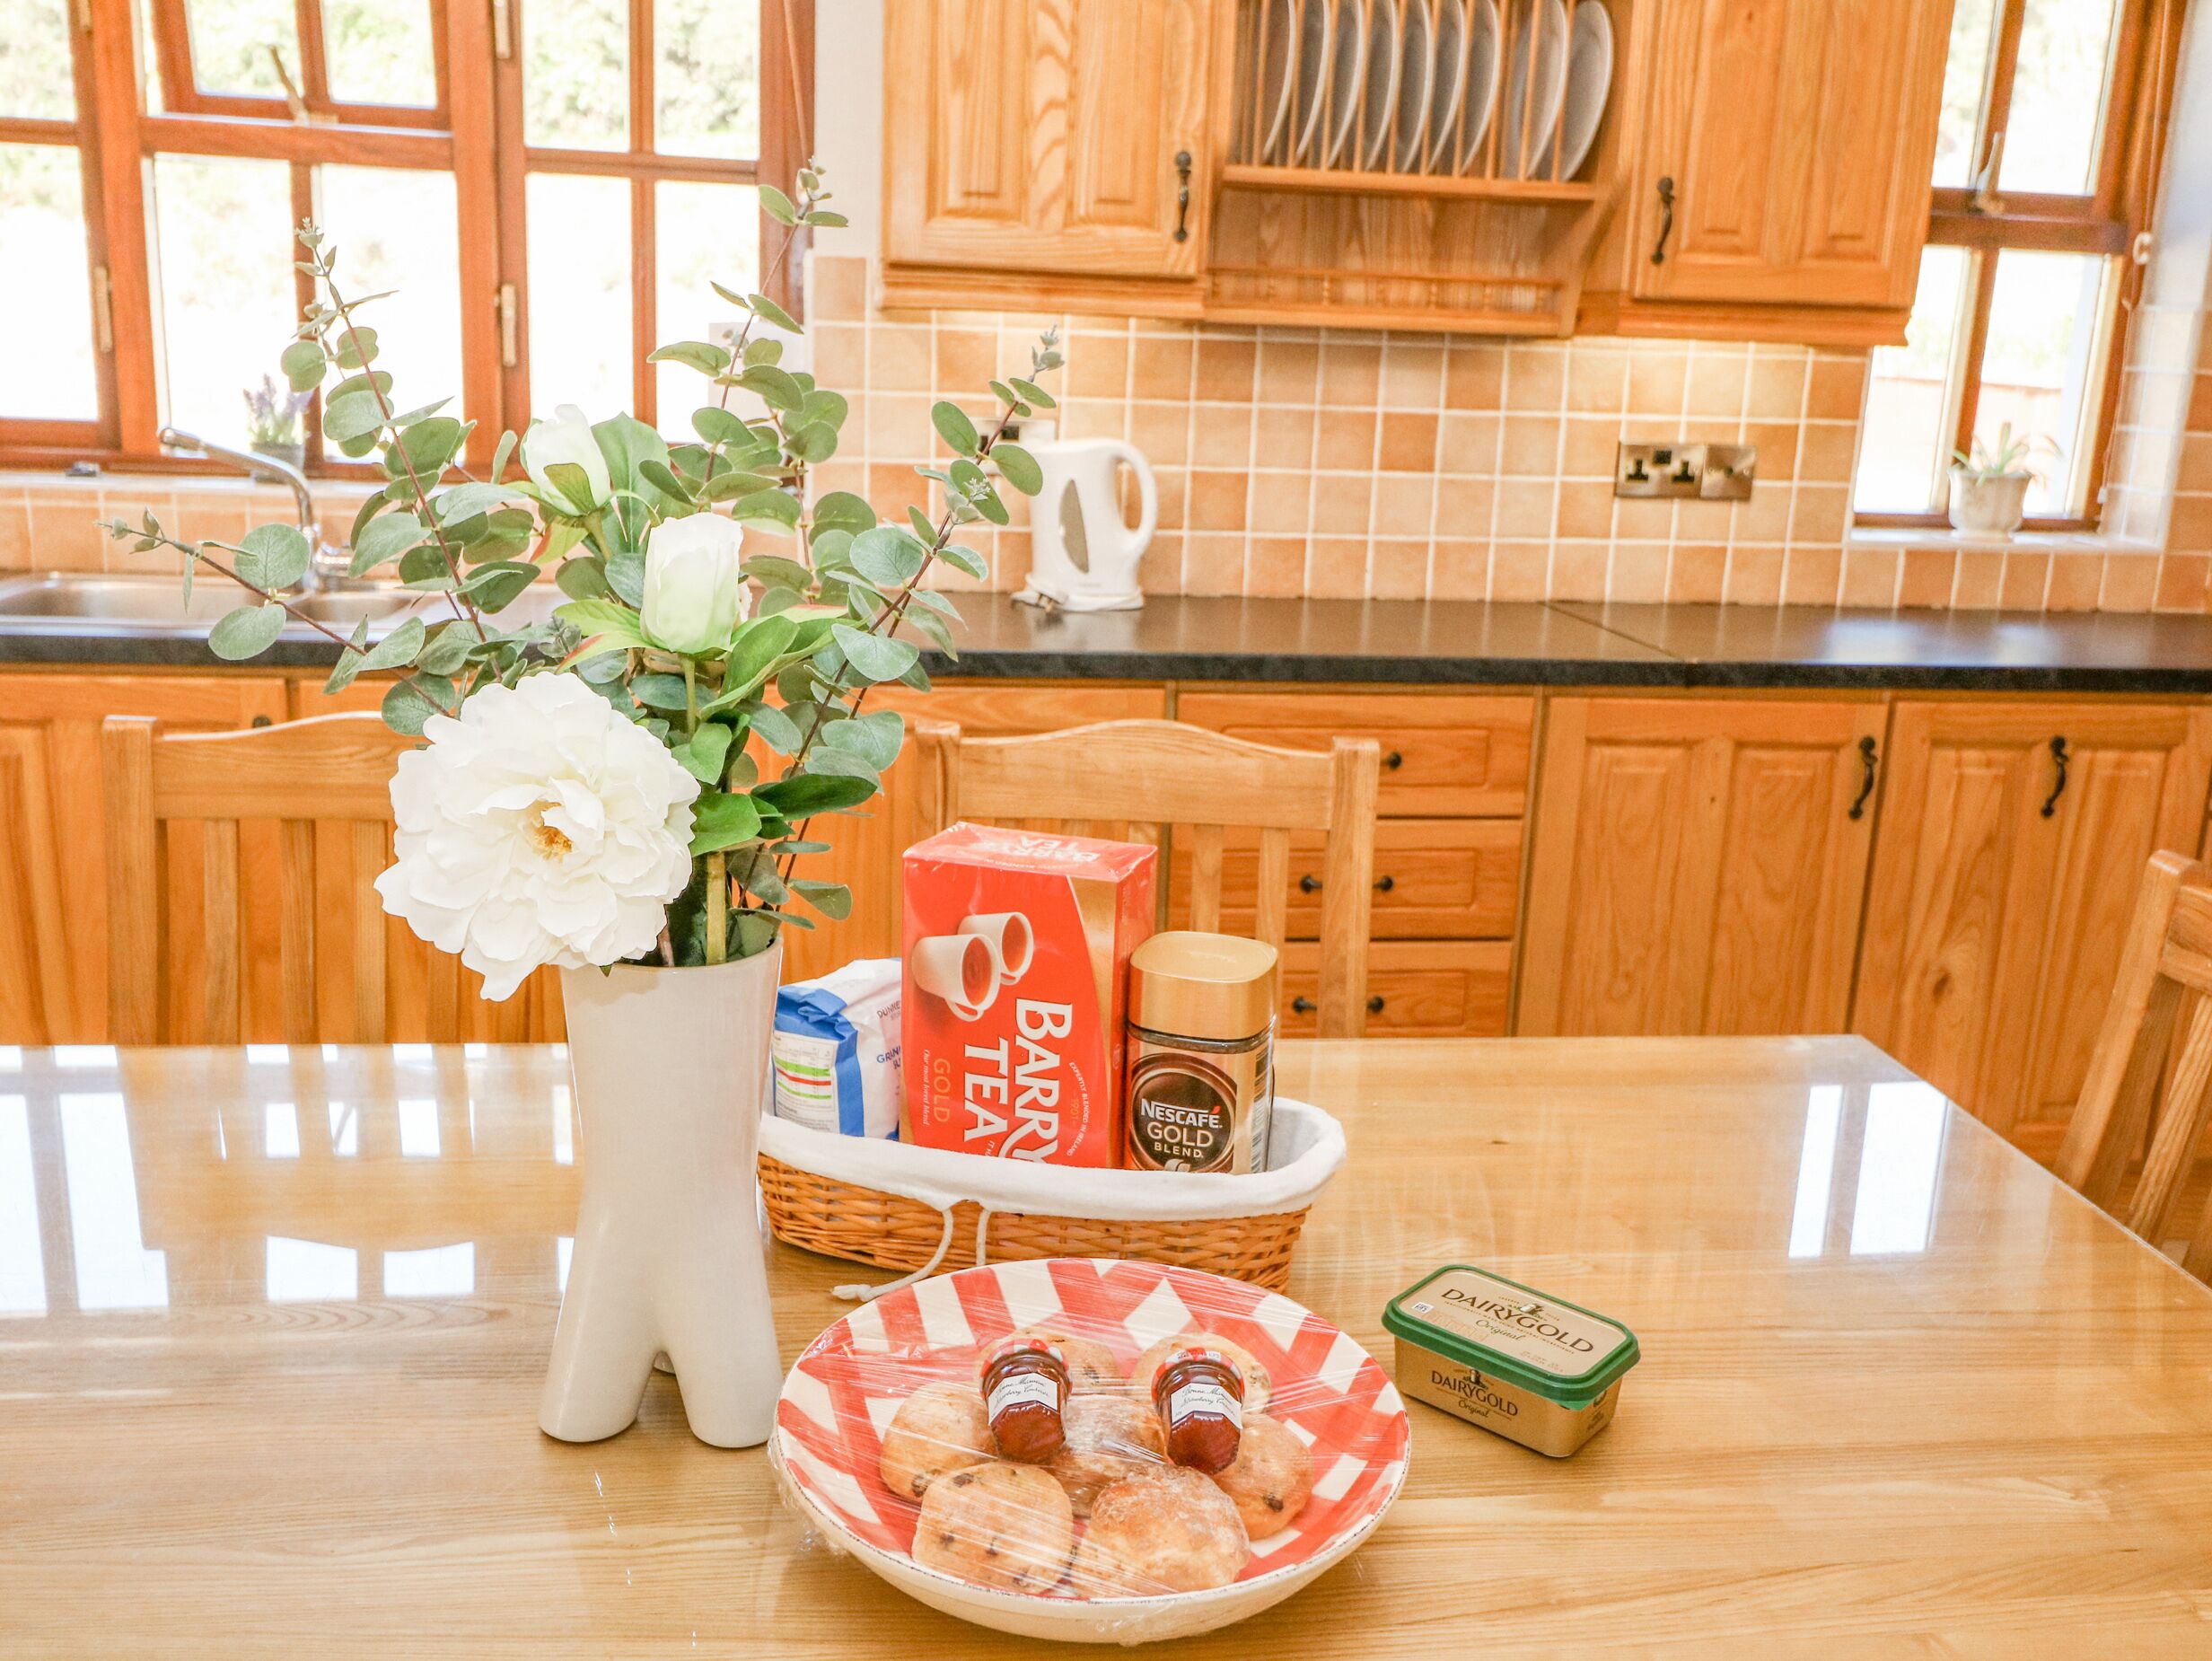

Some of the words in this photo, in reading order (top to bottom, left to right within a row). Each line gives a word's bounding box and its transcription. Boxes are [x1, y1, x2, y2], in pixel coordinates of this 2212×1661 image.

[933, 1058, 952, 1122] GOLD
[963, 1036, 1009, 1142] TEA
[1069, 1061, 1086, 1092] EXPERTLY
[1081, 1093, 1090, 1123] BLENDED
[1141, 1098, 1222, 1129] NESCAFÉ
[1079, 1124, 1087, 1132] IN
[1146, 1121, 1214, 1147] GOLD
[1066, 1131, 1084, 1156] IRELAND
[1154, 1141, 1203, 1158] BLEND
[1441, 1288, 1594, 1352] DAIRYGOLD
[1475, 1319, 1526, 1341] Original
[1431, 1370, 1518, 1416] DAIRYGOLD
[1458, 1400, 1489, 1418] Original
